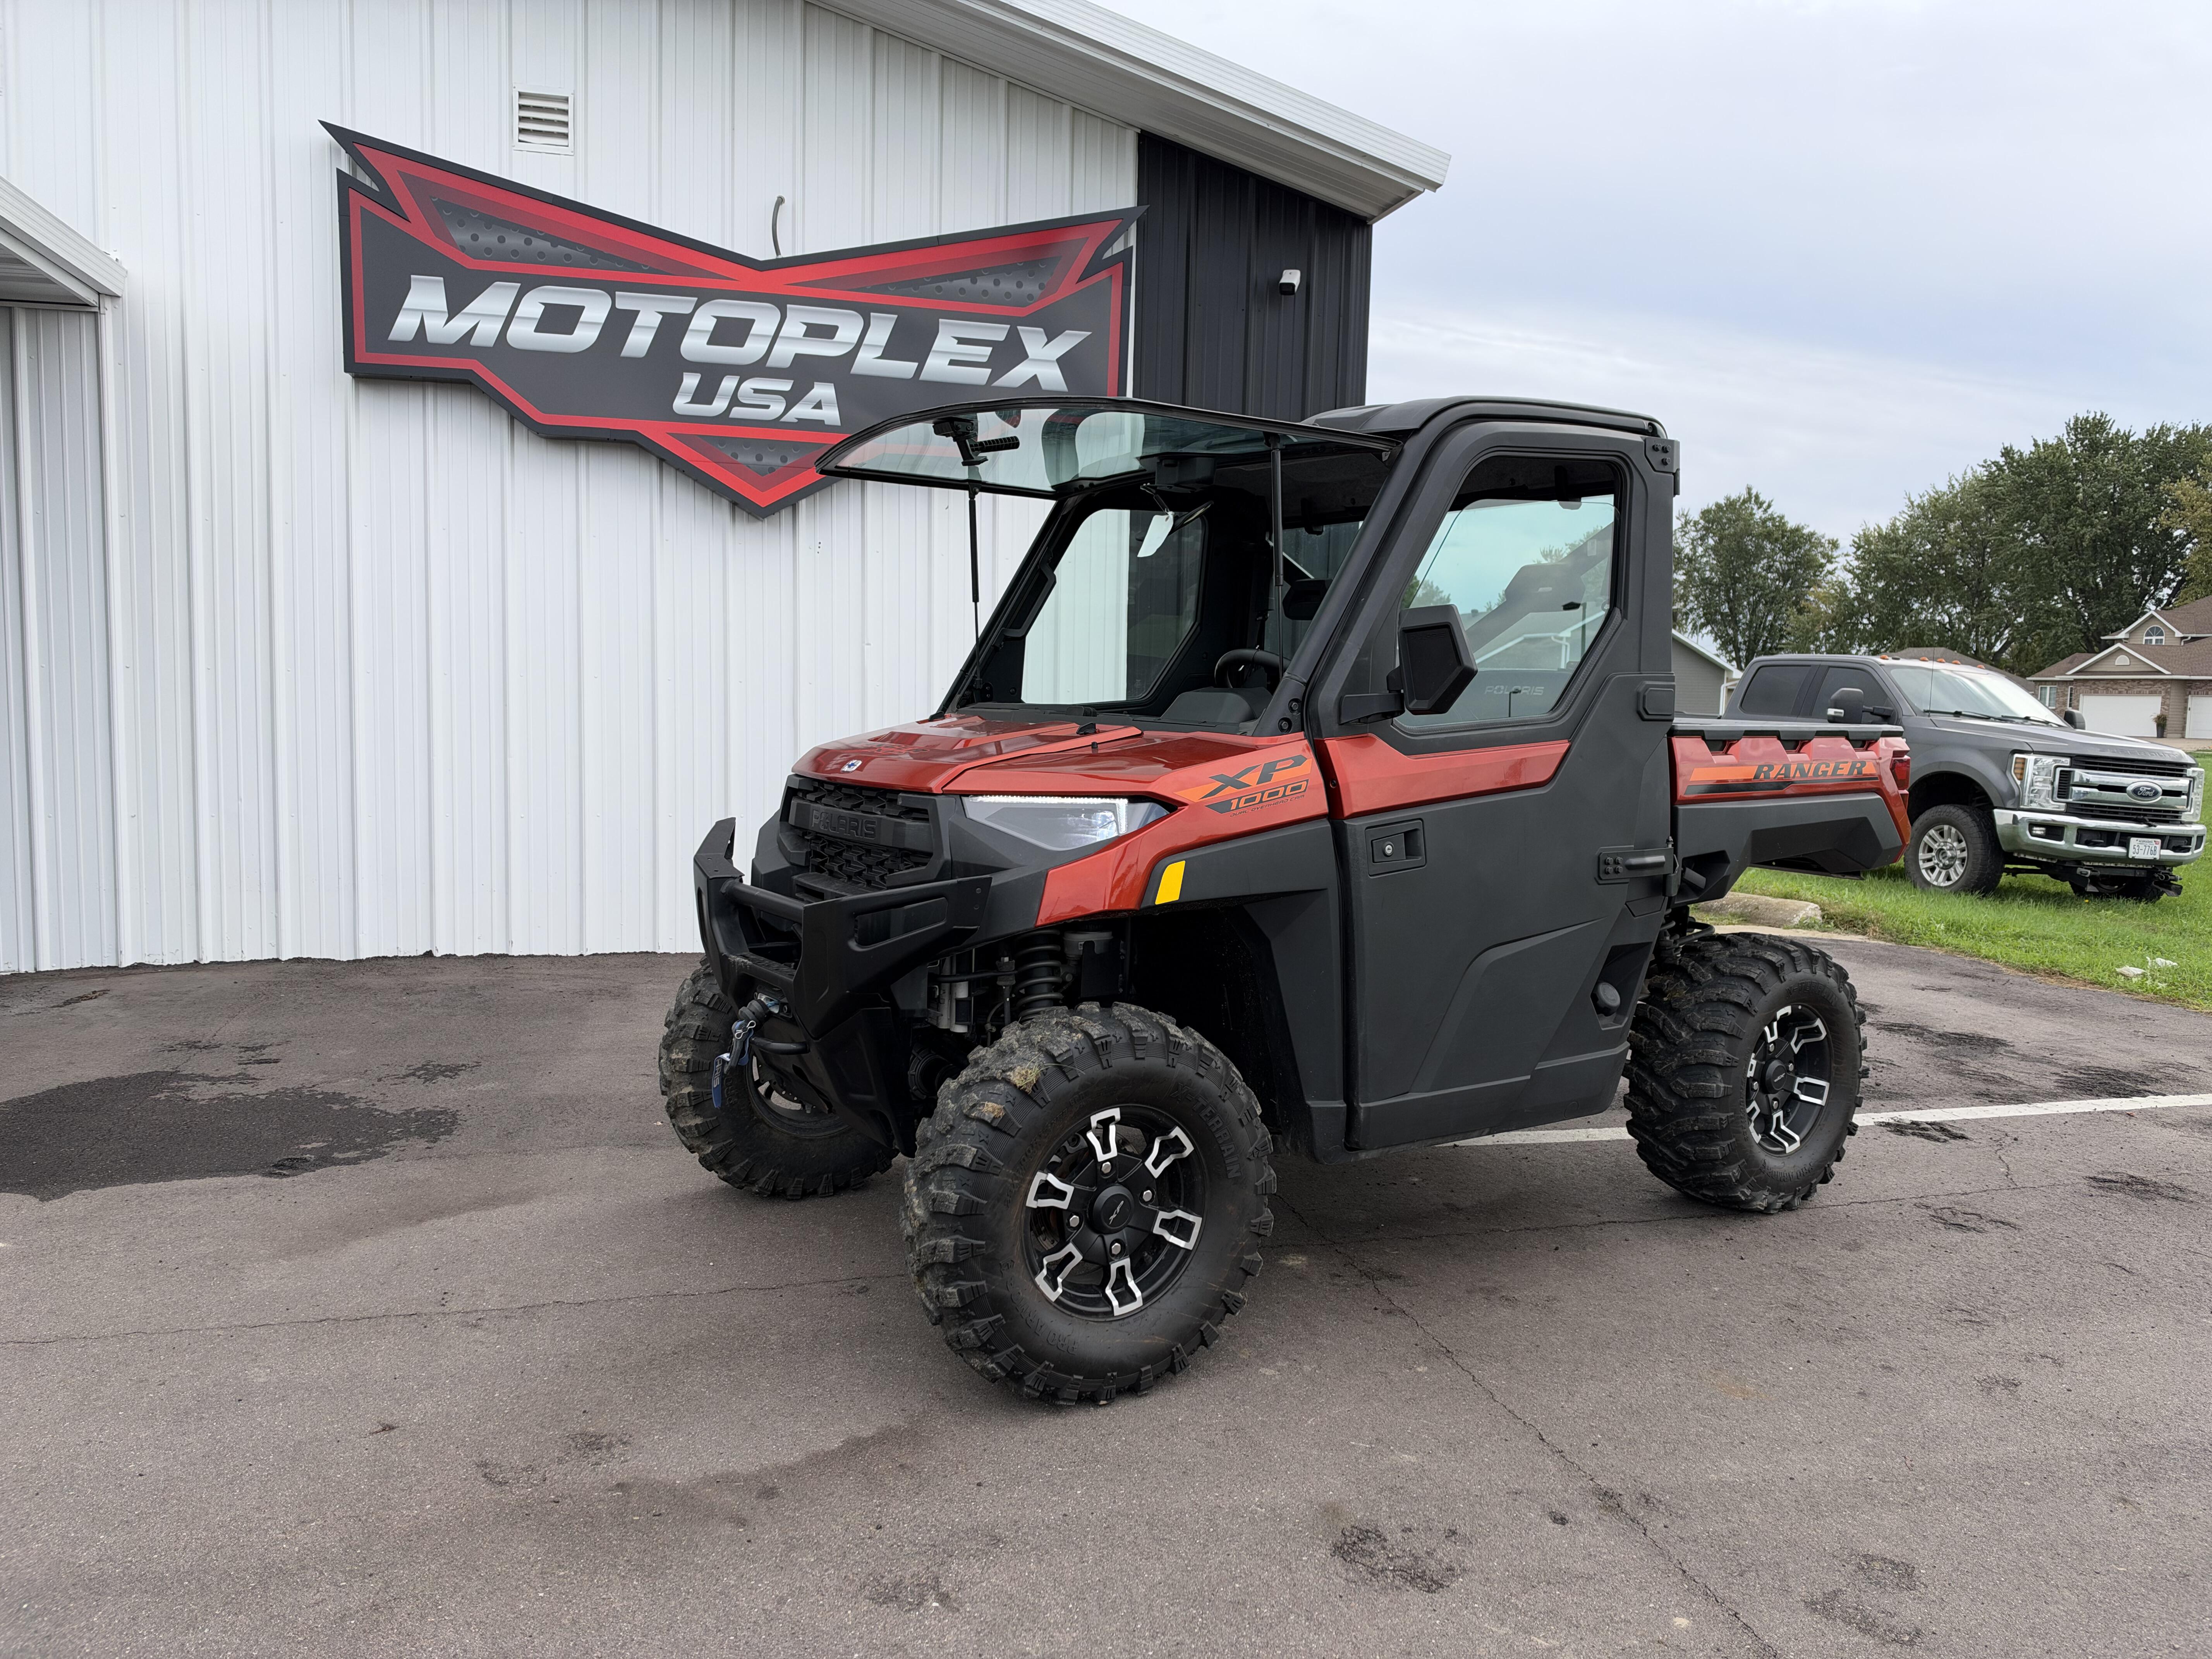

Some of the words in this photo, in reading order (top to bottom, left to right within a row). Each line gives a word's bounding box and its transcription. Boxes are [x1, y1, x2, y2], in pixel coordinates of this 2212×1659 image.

[388, 275, 1091, 392] MOTOPLEX
[673, 373, 842, 426] USA
[1484, 685, 1544, 696] POLARIS
[2099, 748, 2146, 756] SUPER
[1199, 754, 1308, 800] XP
[1752, 761, 1867, 780] RANGER
[1230, 781, 1307, 810] 1000
[2138, 787, 2155, 797] Ford
[1251, 799, 1288, 812] OVERHEAD
[811, 809, 877, 840] POLARIS
[2133, 845, 2157, 855] 53-776B
[1170, 1082, 1242, 1178] X-TERRAIN
[1109, 1200, 1124, 1224] XP
